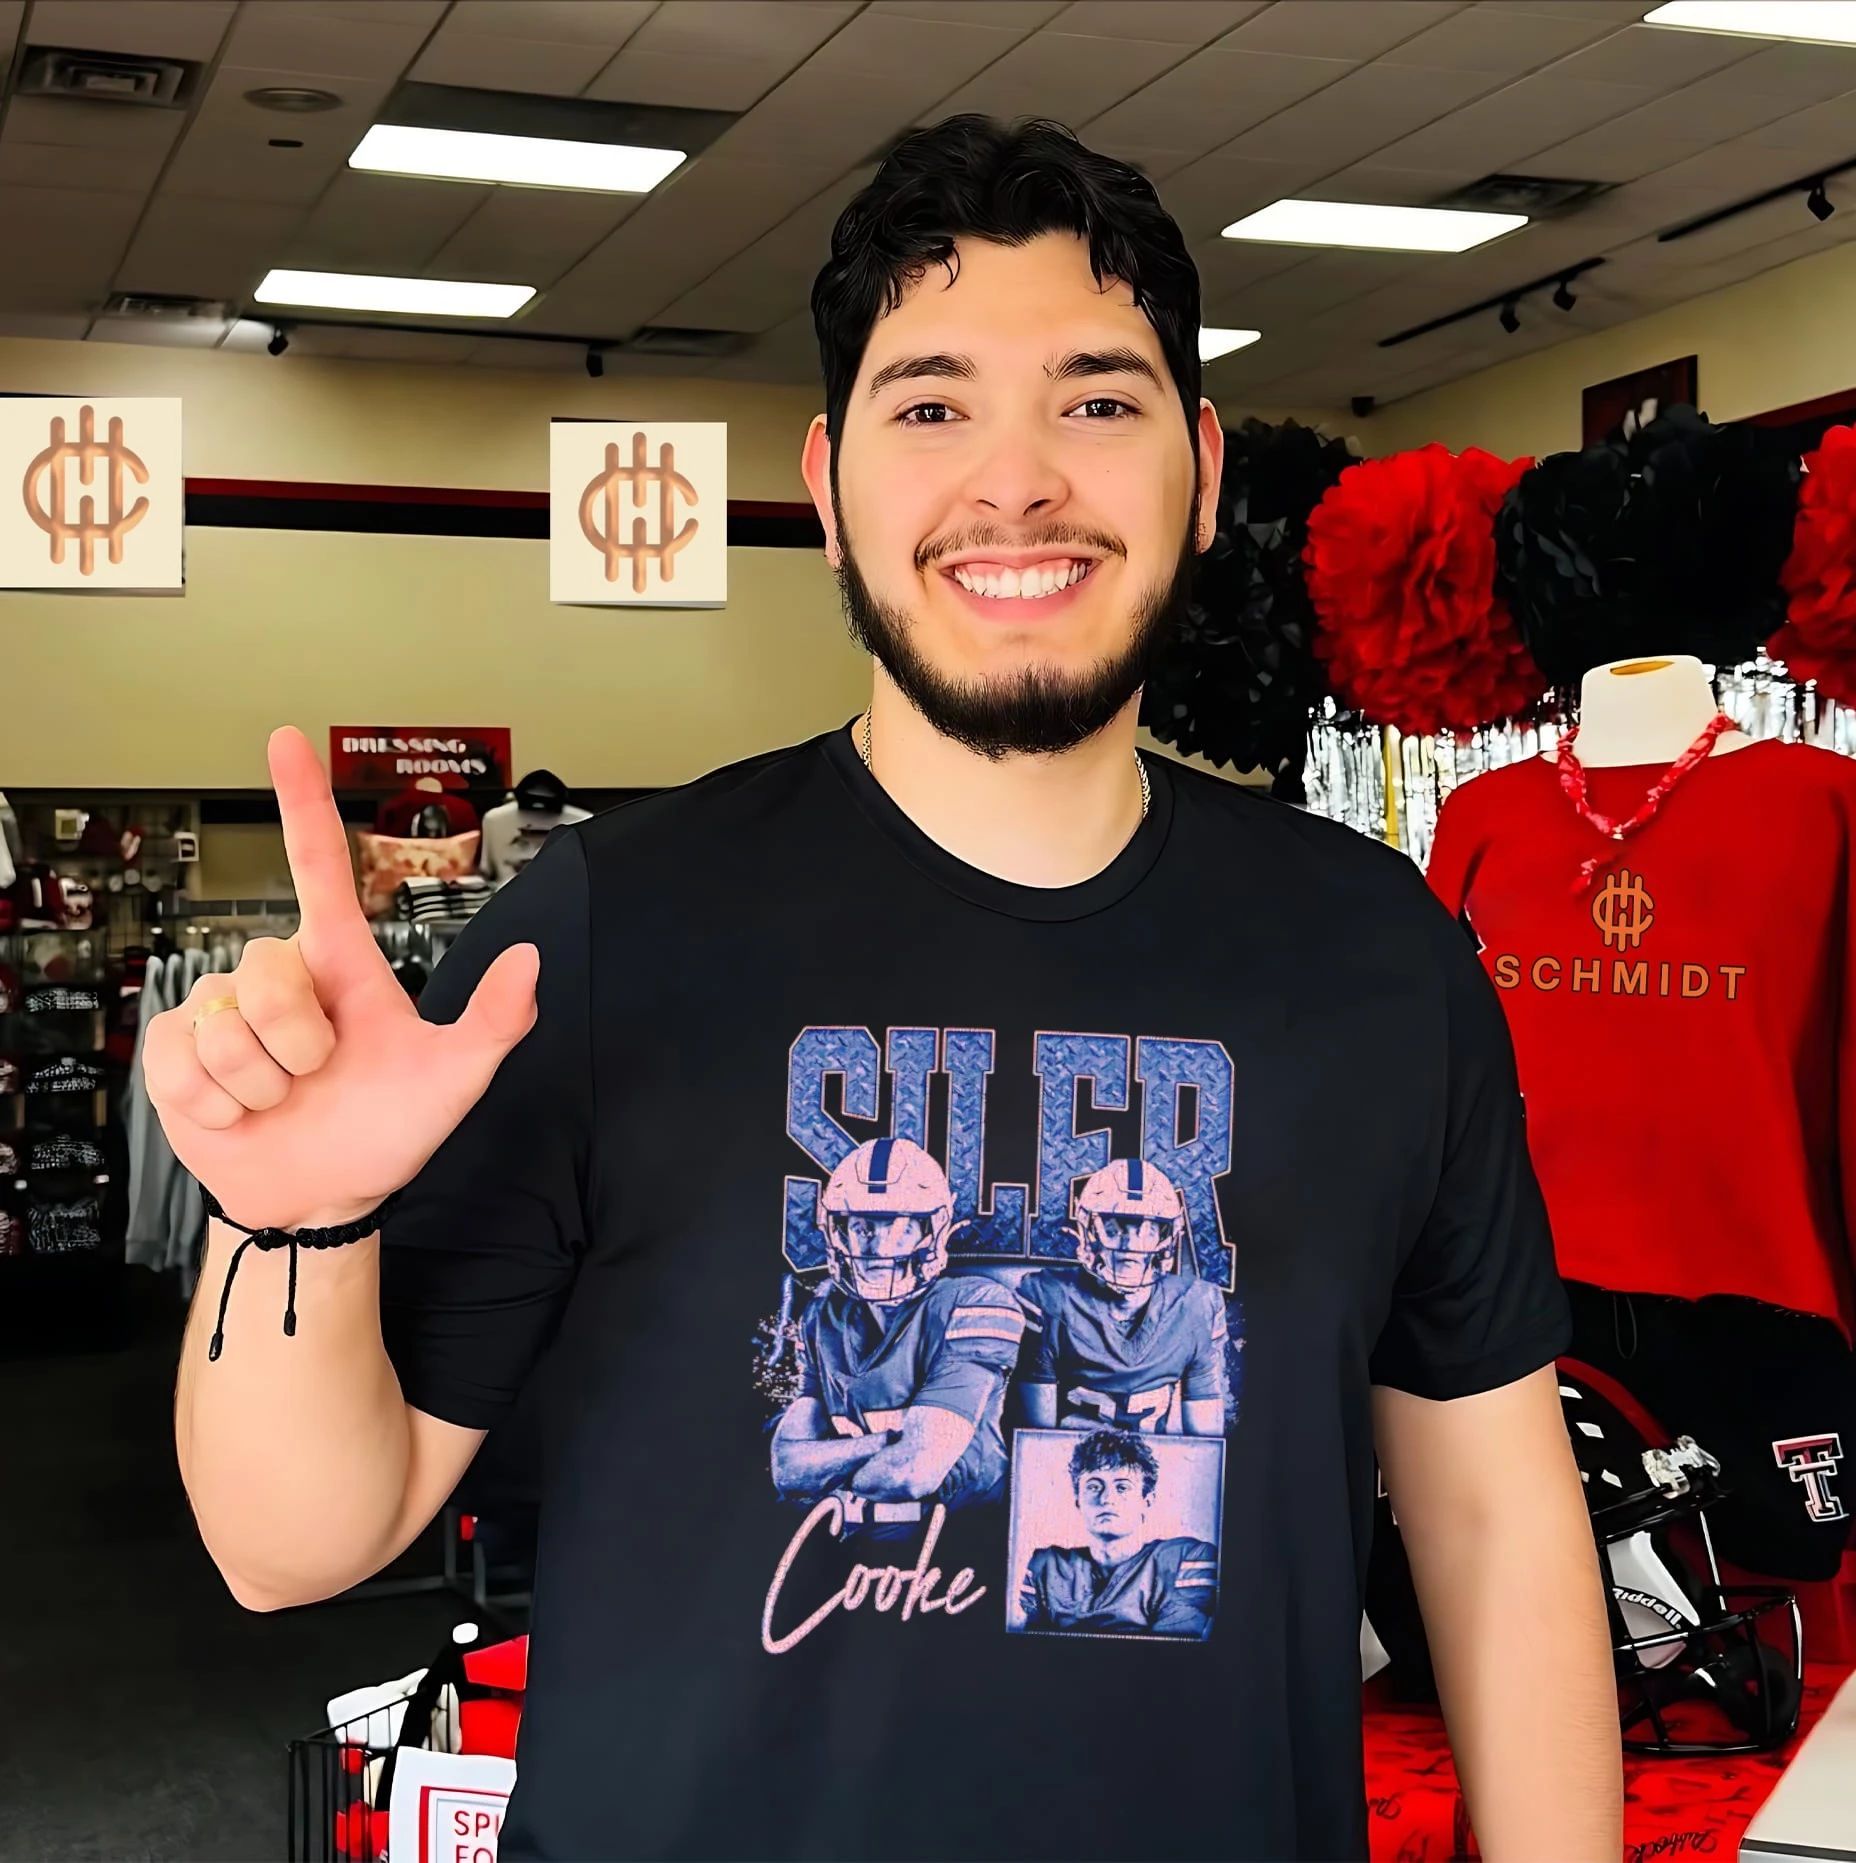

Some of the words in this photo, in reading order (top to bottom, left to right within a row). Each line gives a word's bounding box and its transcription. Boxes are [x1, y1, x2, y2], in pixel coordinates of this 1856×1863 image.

[396, 758, 487, 775] ROOMS
[1494, 954, 1746, 999] SCHMIDT
[782, 1026, 1236, 1293] SILER
[761, 1494, 987, 1654] Cooke
